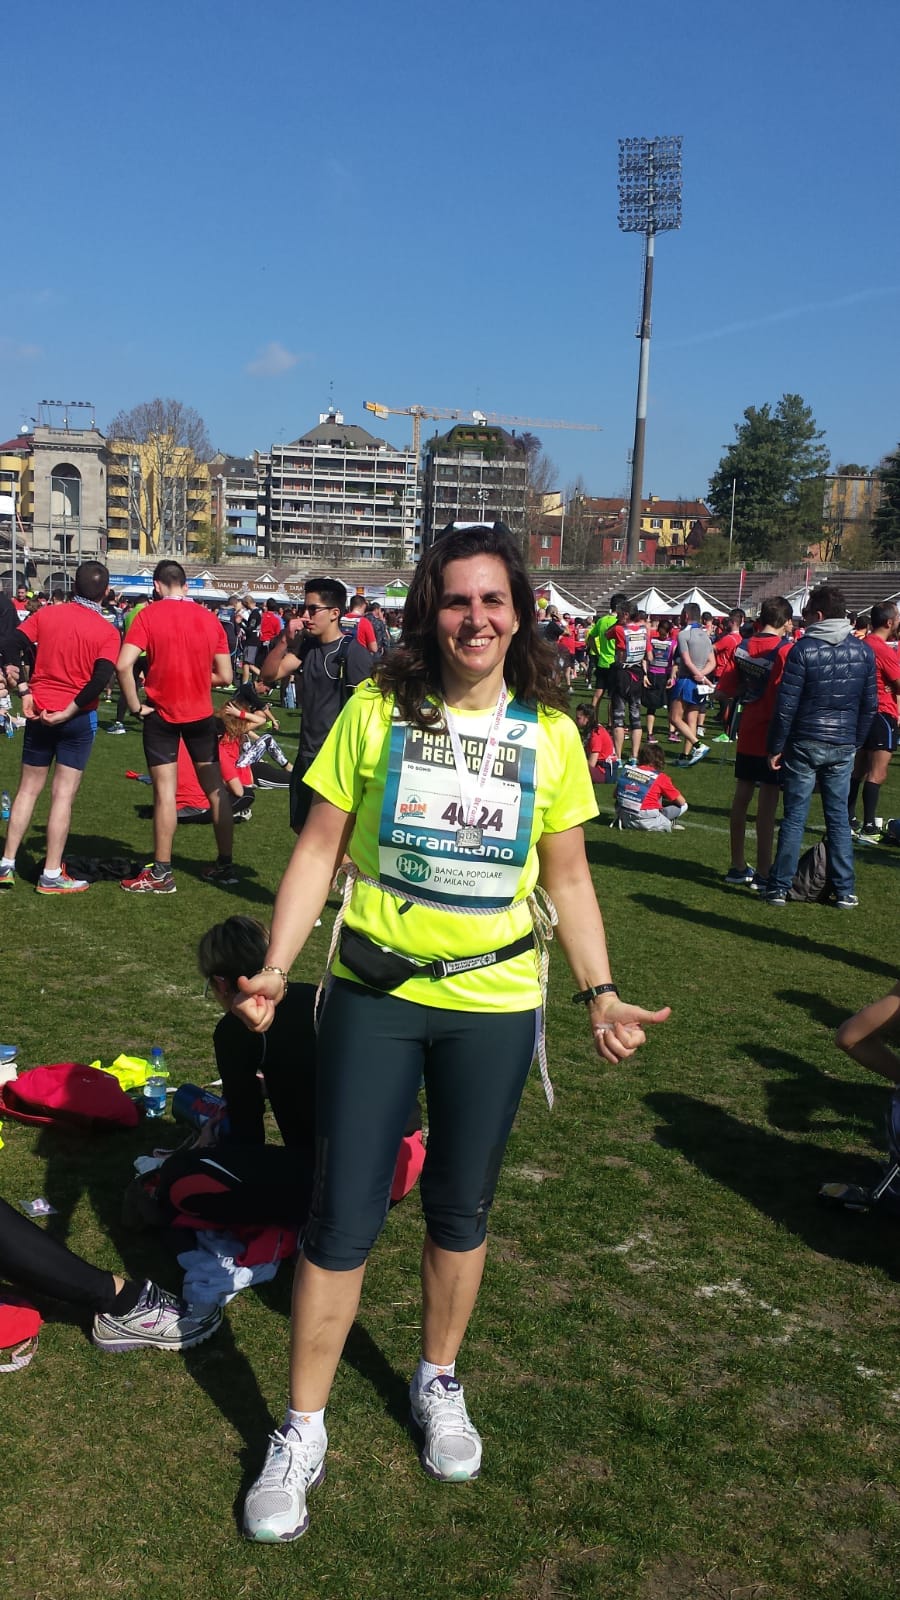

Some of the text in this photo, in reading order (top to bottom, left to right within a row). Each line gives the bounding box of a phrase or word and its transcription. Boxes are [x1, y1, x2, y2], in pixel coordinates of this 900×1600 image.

[411, 729, 516, 763] PARIGINO
[422, 745, 504, 777] REGIAO
[400, 803, 427, 813] RUN
[398, 856, 430, 880] BPM
[435, 866, 503, 879] BANCA POPOLARE
[443, 878, 476, 887] MILANO
